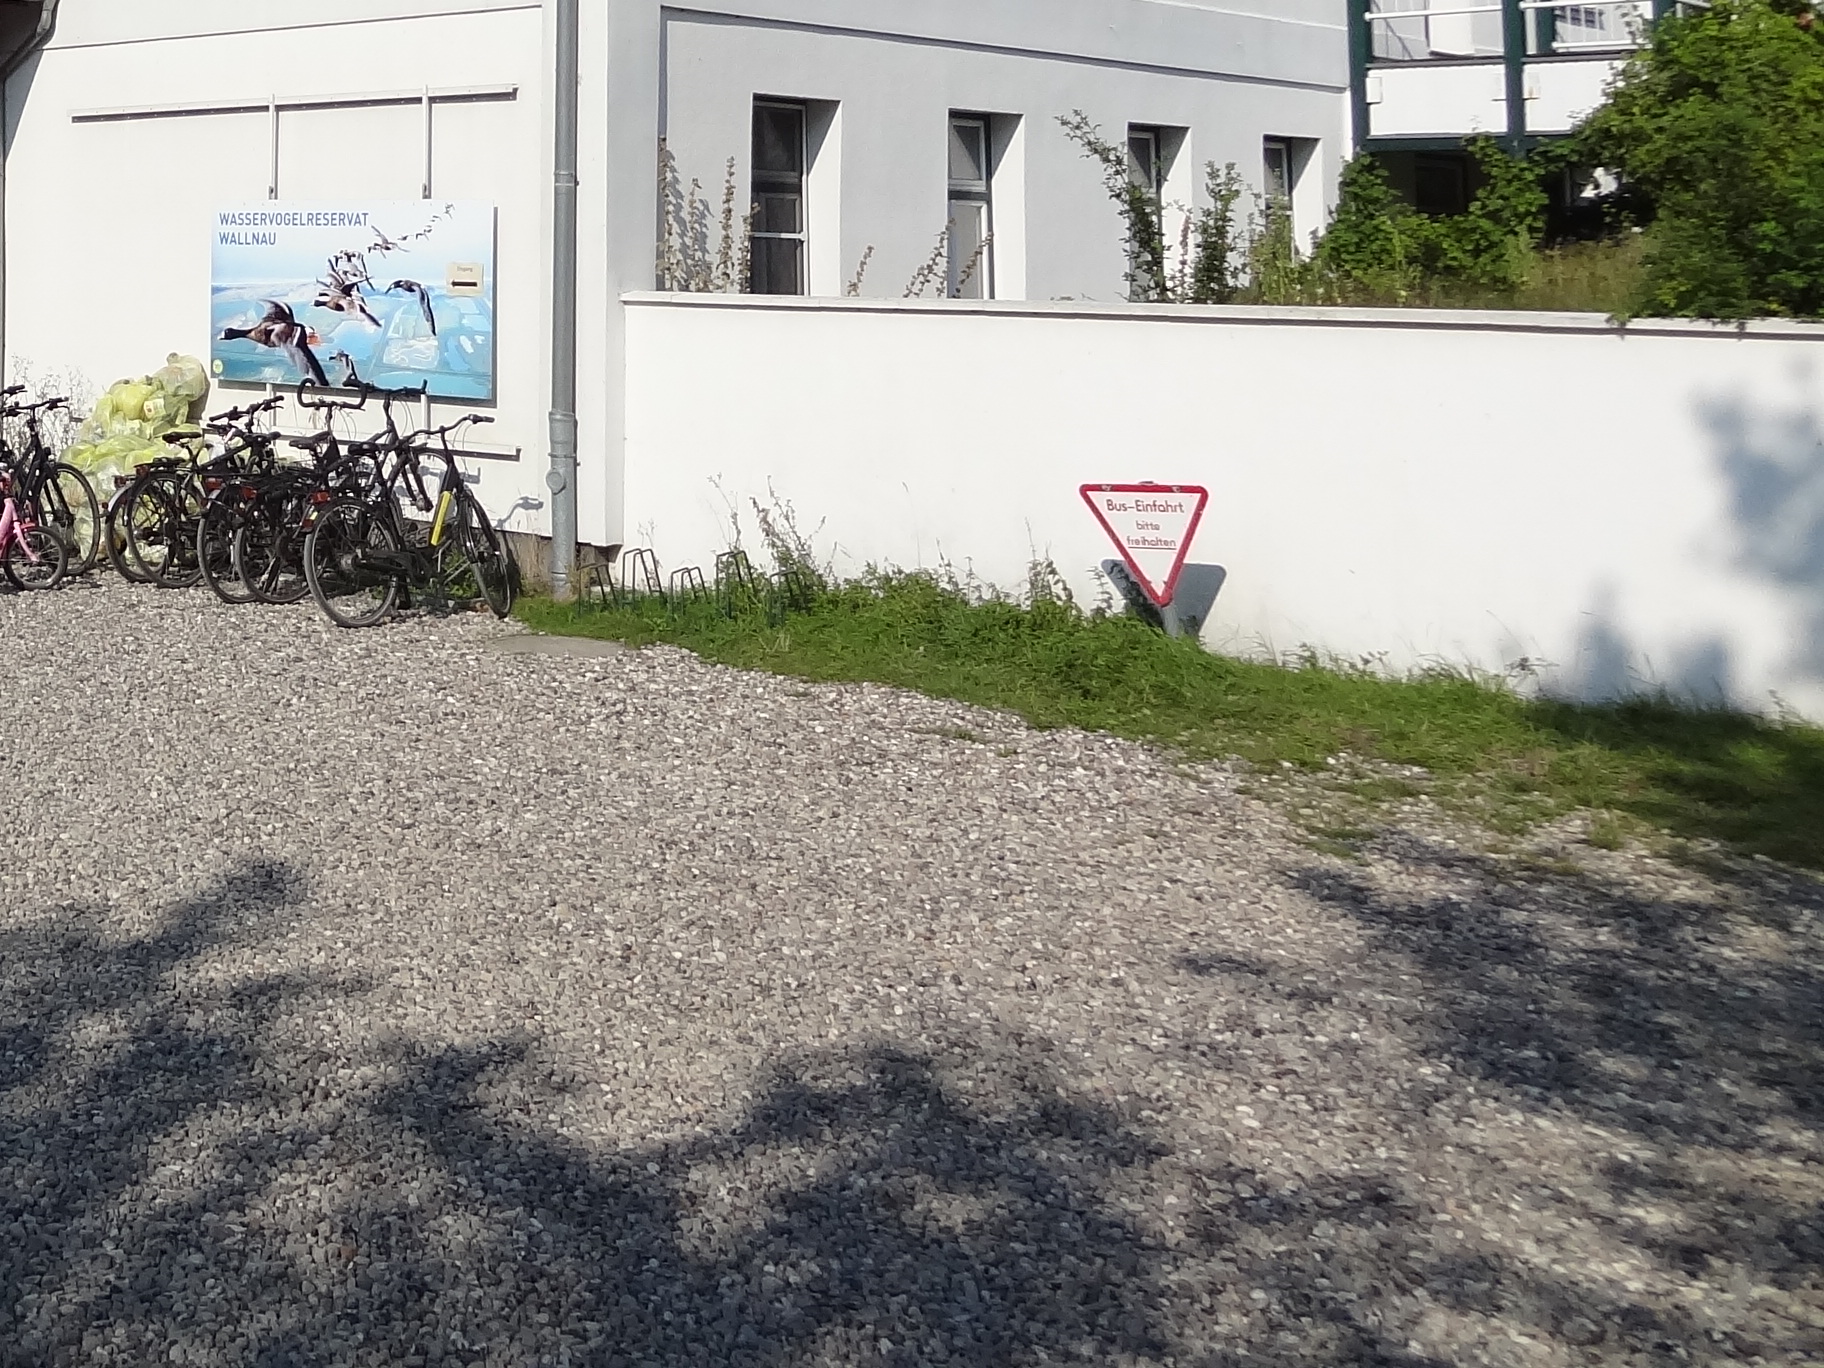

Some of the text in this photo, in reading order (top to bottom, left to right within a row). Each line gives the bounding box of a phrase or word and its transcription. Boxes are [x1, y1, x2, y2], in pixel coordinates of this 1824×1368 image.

[218, 212, 369, 226] WASSERVOGELRESERVAT
[218, 231, 277, 245] WALLNAU
[1106, 498, 1184, 513] Bus-Einfahrt
[1135, 520, 1160, 531] bitte
[1127, 536, 1176, 547] freihalten
